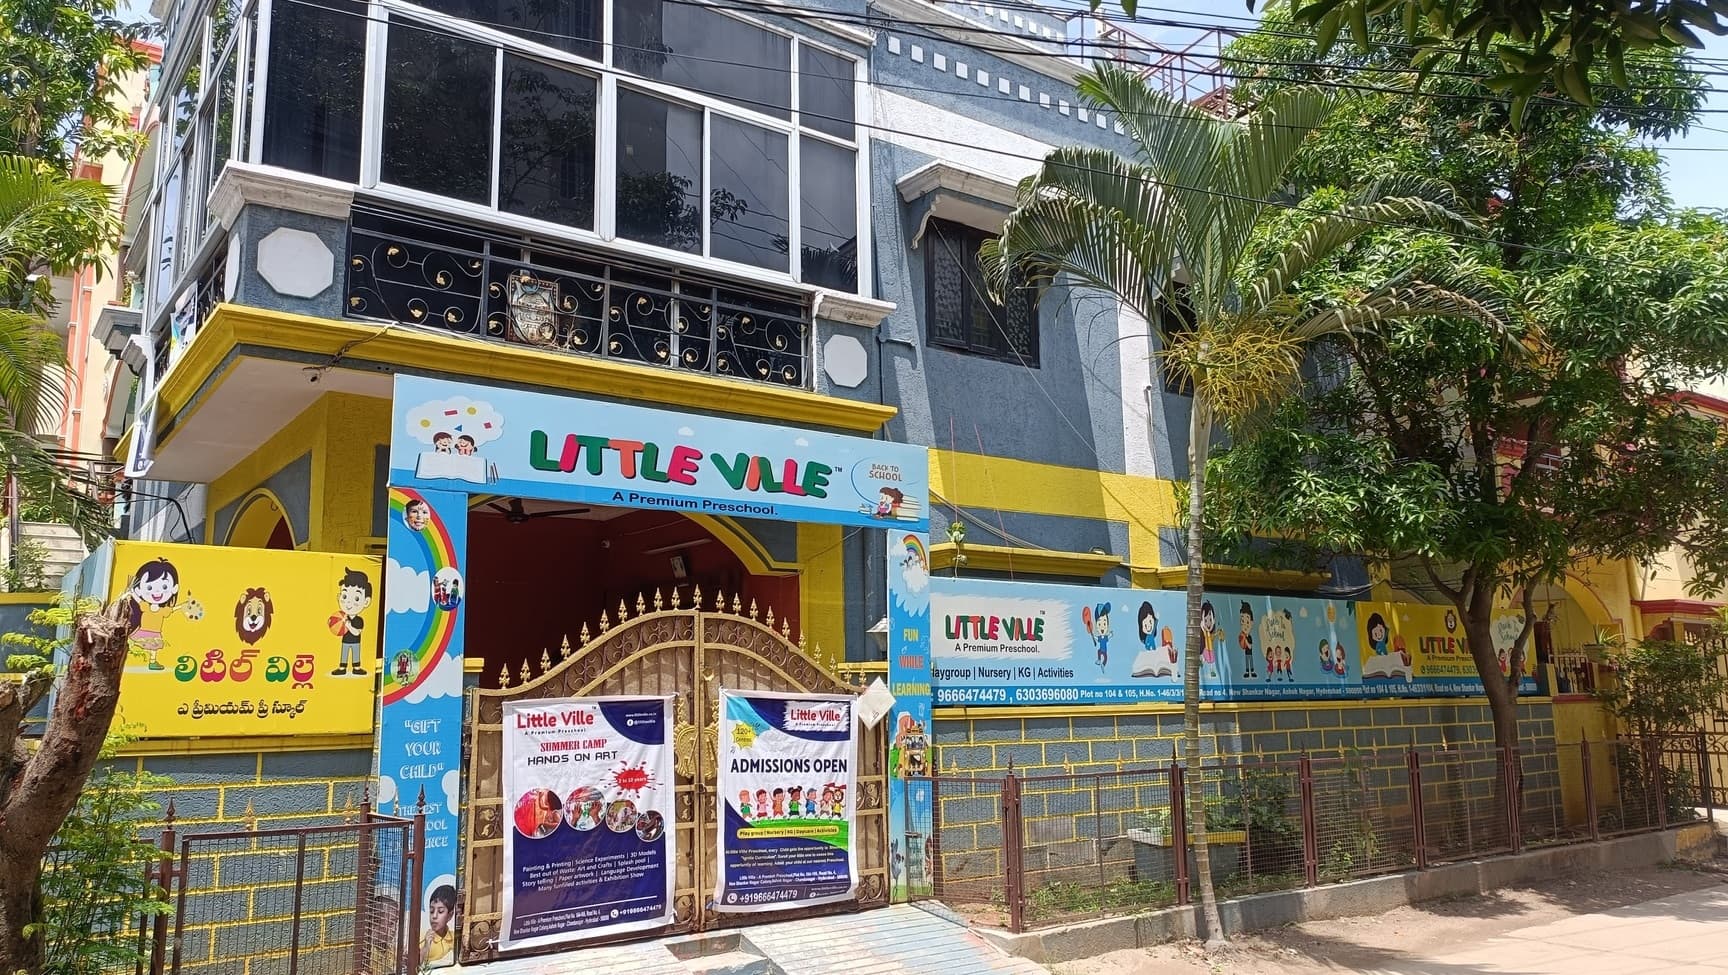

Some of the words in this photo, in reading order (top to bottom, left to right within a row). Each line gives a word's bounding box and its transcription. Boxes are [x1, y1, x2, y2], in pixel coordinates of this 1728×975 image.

[530, 430, 702, 486] LITTLE
[711, 452, 832, 498] VILLE
[869, 470, 902, 482] SCHOOL
[612, 492, 624, 502] A
[628, 492, 698, 510] Premium
[702, 499, 778, 516] Preschool.
[904, 628, 918, 642] FUN
[945, 614, 1000, 640] LITTLE
[1002, 616, 1045, 642] VILLE
[955, 643, 962, 652] A
[963, 643, 998, 652] Premium
[1000, 644, 1040, 653] Preschool.
[1420, 636, 1455, 654] LITTLE
[174, 649, 260, 682] లిటిల్
[899, 656, 924, 669] WHILE
[933, 667, 971, 680] laygroup
[978, 667, 1011, 680] Nursery
[1018, 668, 1031, 678] KG
[1038, 668, 1074, 679] Activities
[938, 689, 1006, 702] 9666474479
[1016, 688, 1078, 701] 6303696080
[1080, 690, 1093, 698] Plot
[1105, 690, 1116, 698] 104
[257, 700, 268, 718] ప్రీ
[272, 700, 308, 719] స్కూల్
[791, 709, 816, 720] Little
[820, 710, 840, 721] Ville
[517, 711, 557, 728] Little
[560, 710, 594, 725] Ville
[405, 742, 442, 757] YOUR
[540, 741, 580, 752] SUMMER
[583, 739, 607, 750] CAMP
[528, 754, 568, 766] HANDS
[574, 753, 590, 762] ON
[595, 751, 618, 760] ART
[730, 758, 810, 773] ADMISSIONS
[813, 759, 847, 773] OPEN
[419, 802, 442, 814] EST
[740, 890, 797, 903] +919666474479
